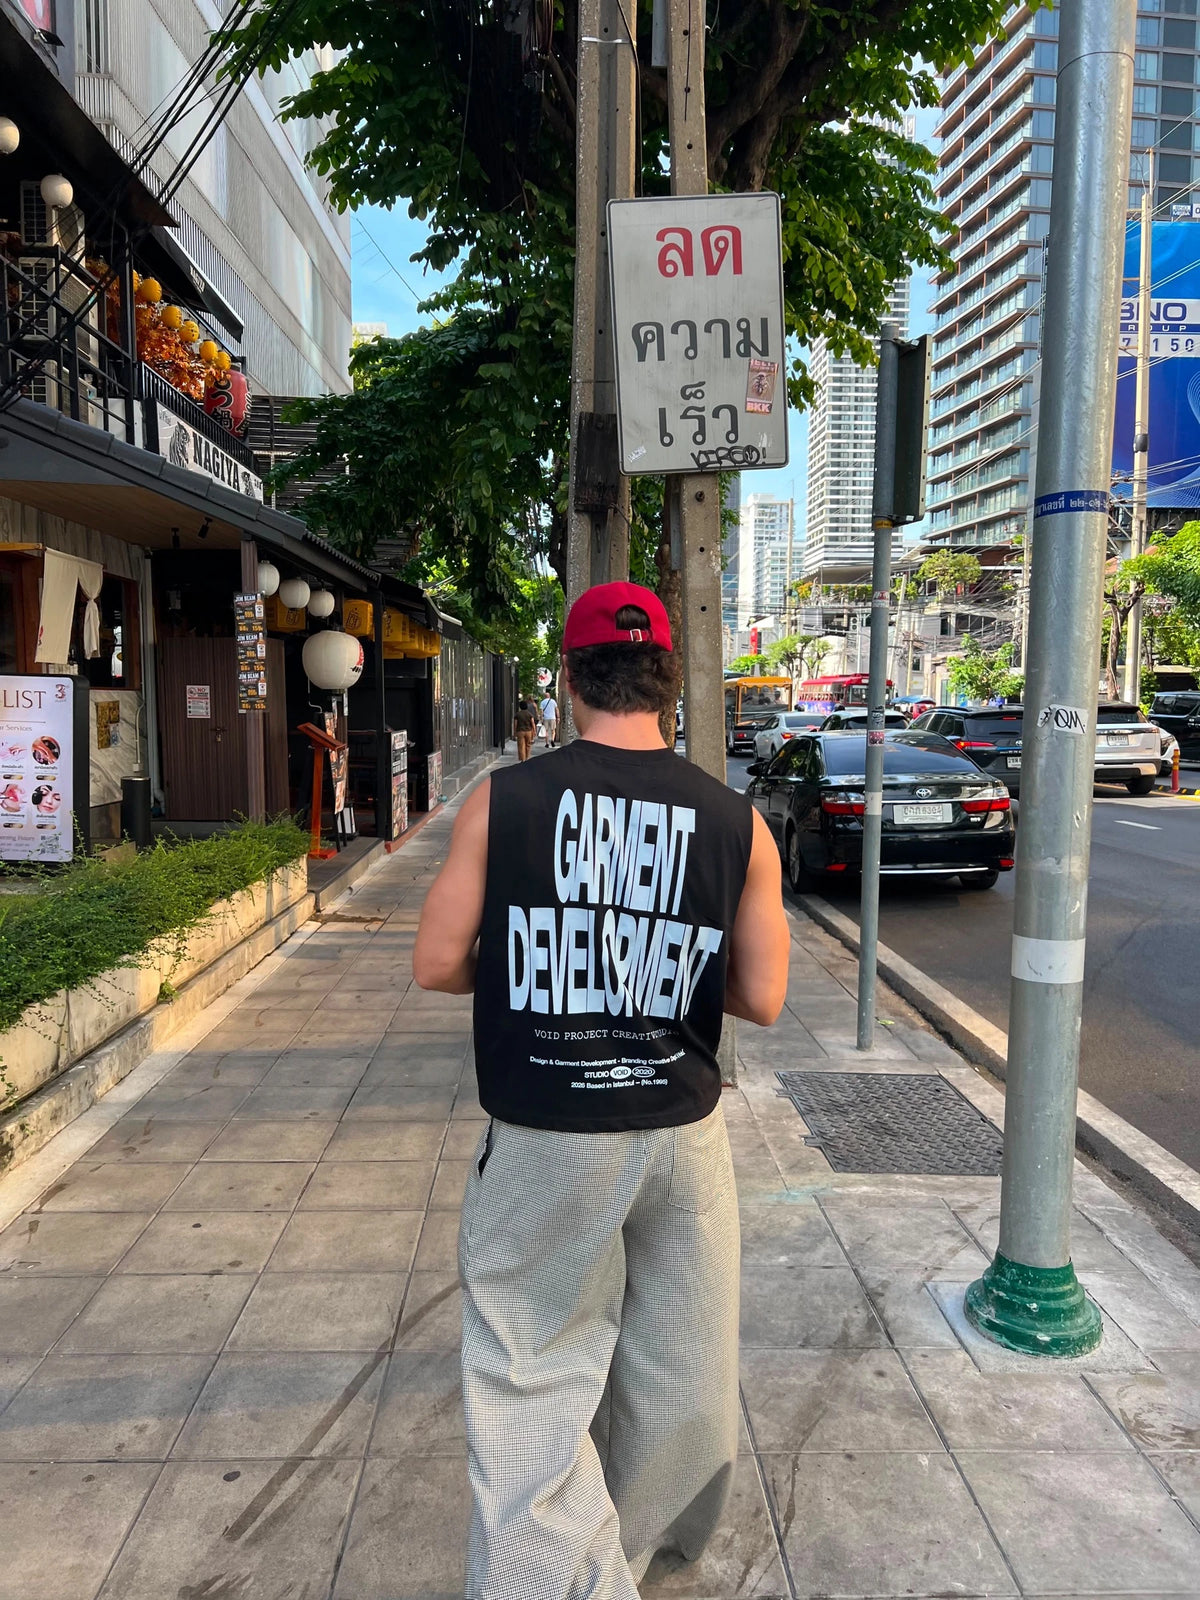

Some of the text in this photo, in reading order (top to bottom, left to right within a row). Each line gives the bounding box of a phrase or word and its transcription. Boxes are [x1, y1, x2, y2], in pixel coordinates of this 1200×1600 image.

[655, 225, 743, 278] ลด
[631, 317, 769, 362] ความ
[658, 380, 739, 447] เร็ว
[746, 402, 770, 413] BKK
[193, 431, 240, 493] NAGIYA
[3, 689, 47, 709] LIST
[553, 788, 696, 916] GARMENT
[508, 905, 723, 1022] DEVELOPMENT
[534, 1029, 560, 1040] VOID
[564, 1029, 609, 1040] PROJECT
[529, 1056, 549, 1066] Design
[554, 1059, 580, 1067] Garment
[580, 1058, 617, 1067] Development
[621, 1057, 647, 1066] Branding
[648, 1057, 670, 1065] Creative
[584, 1071, 609, 1079] STUDIO
[613, 1068, 629, 1077] VOID
[586, 1081, 605, 1089] Based
[612, 1079, 635, 1088] Istanbul
